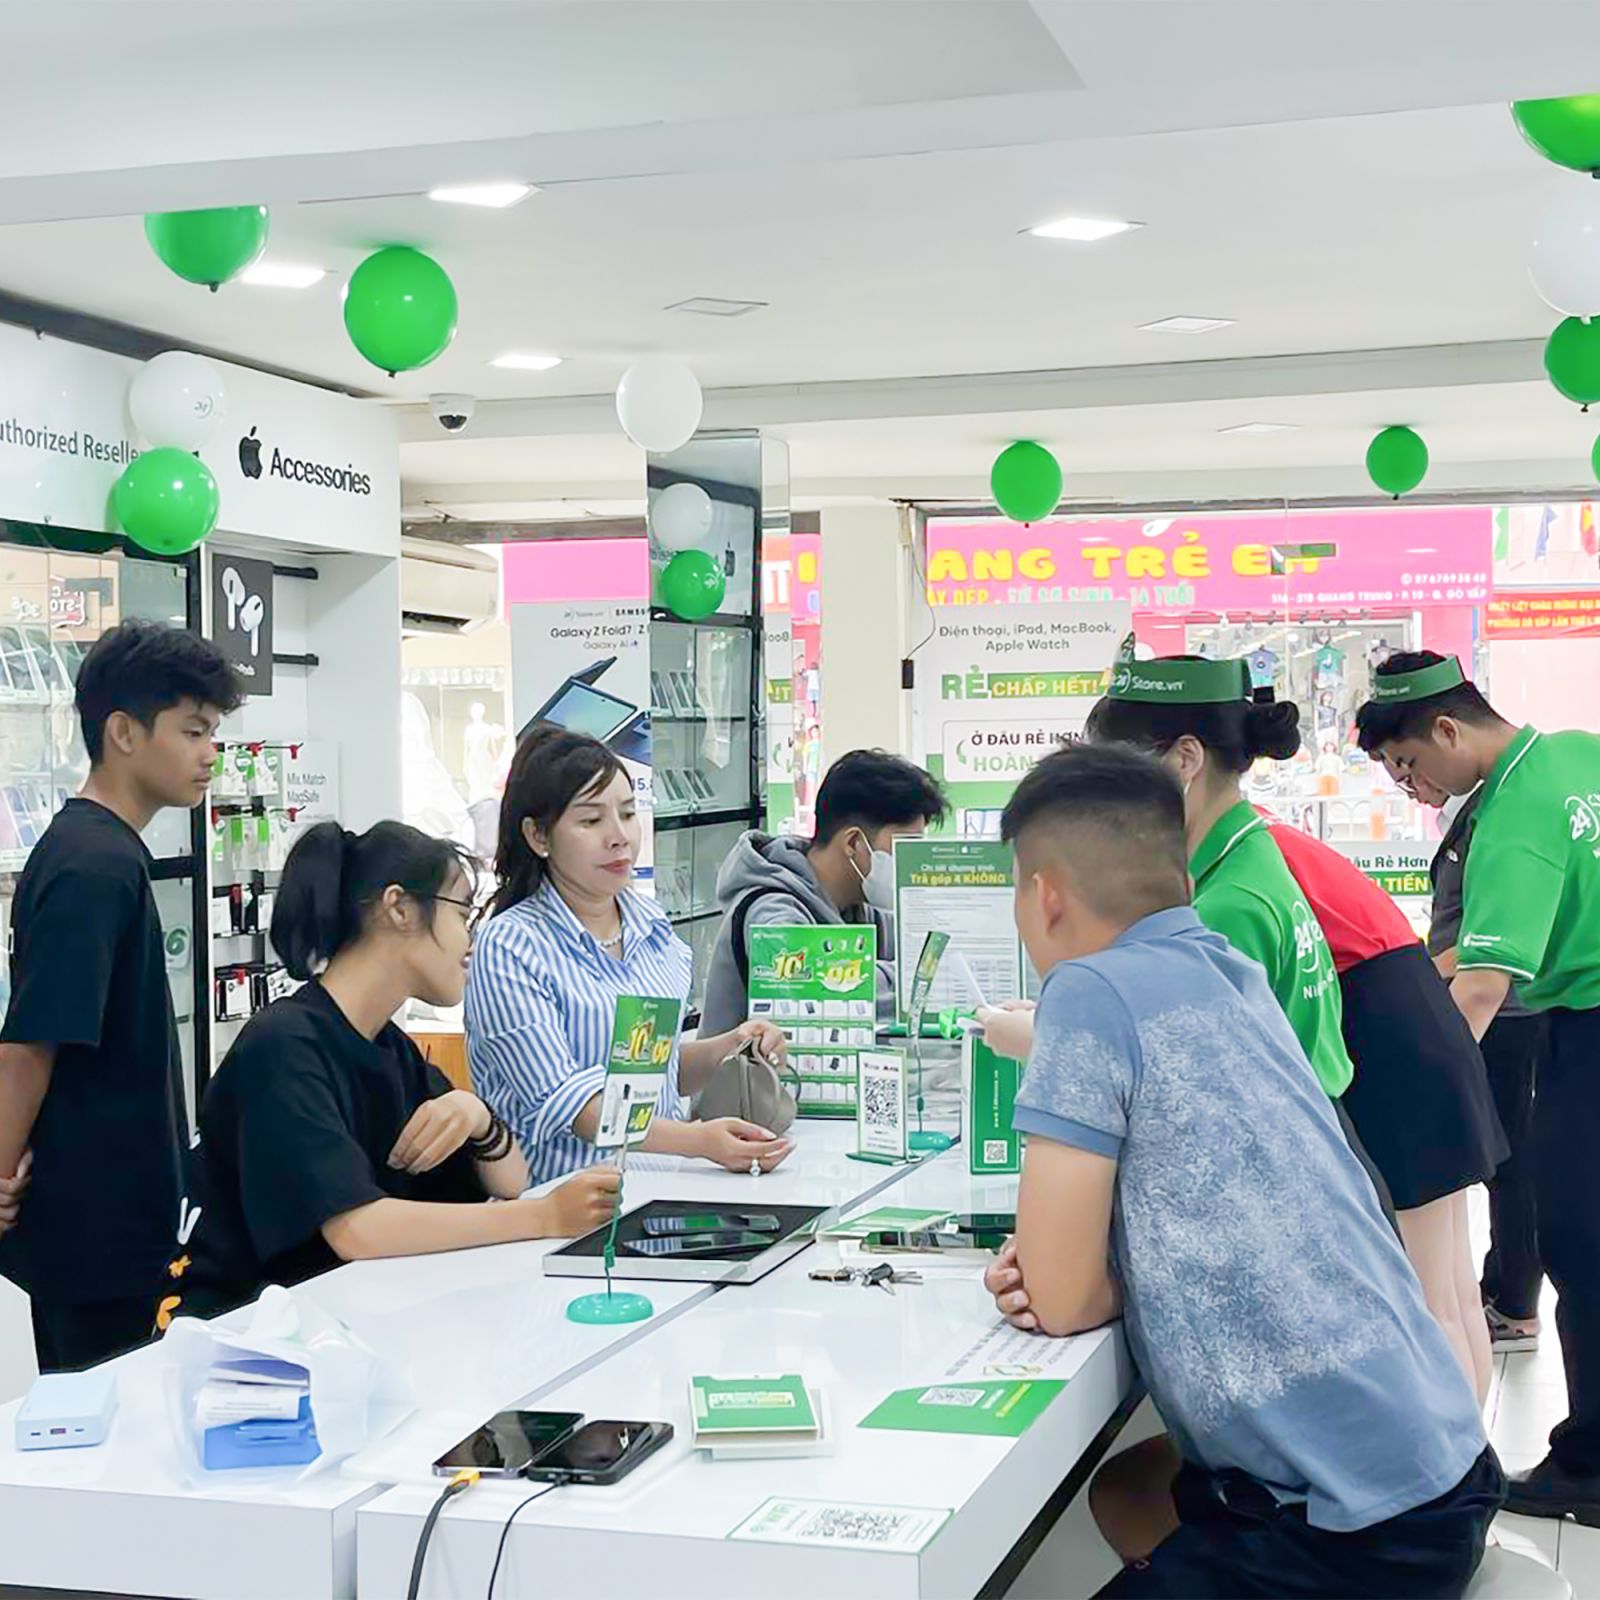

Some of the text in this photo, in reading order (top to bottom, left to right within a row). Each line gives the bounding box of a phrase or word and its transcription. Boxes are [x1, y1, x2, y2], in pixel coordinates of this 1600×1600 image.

[83, 433, 140, 464] Reselle
[270, 447, 371, 495] Accessories
[1081, 532, 1209, 578] TRẺ
[550, 626, 592, 640] Galaxy
[593, 625, 601, 637] Z
[602, 624, 632, 636] Fold7
[939, 624, 969, 638] Điện
[1014, 621, 1047, 637] iPad,
[1051, 620, 1117, 636] MacBook,
[583, 640, 618, 651] Galaxy
[985, 639, 1070, 653] Apple Watch
[992, 675, 1047, 697] CHẤP
[1053, 674, 1098, 695] HẾT!
[971, 729, 983, 746] Ở
[986, 731, 1020, 746] ĐÂU
[1025, 728, 1045, 745] RẺ
[1398, 855, 1428, 869] Hơn
[963, 871, 1006, 884] KHÔNG
